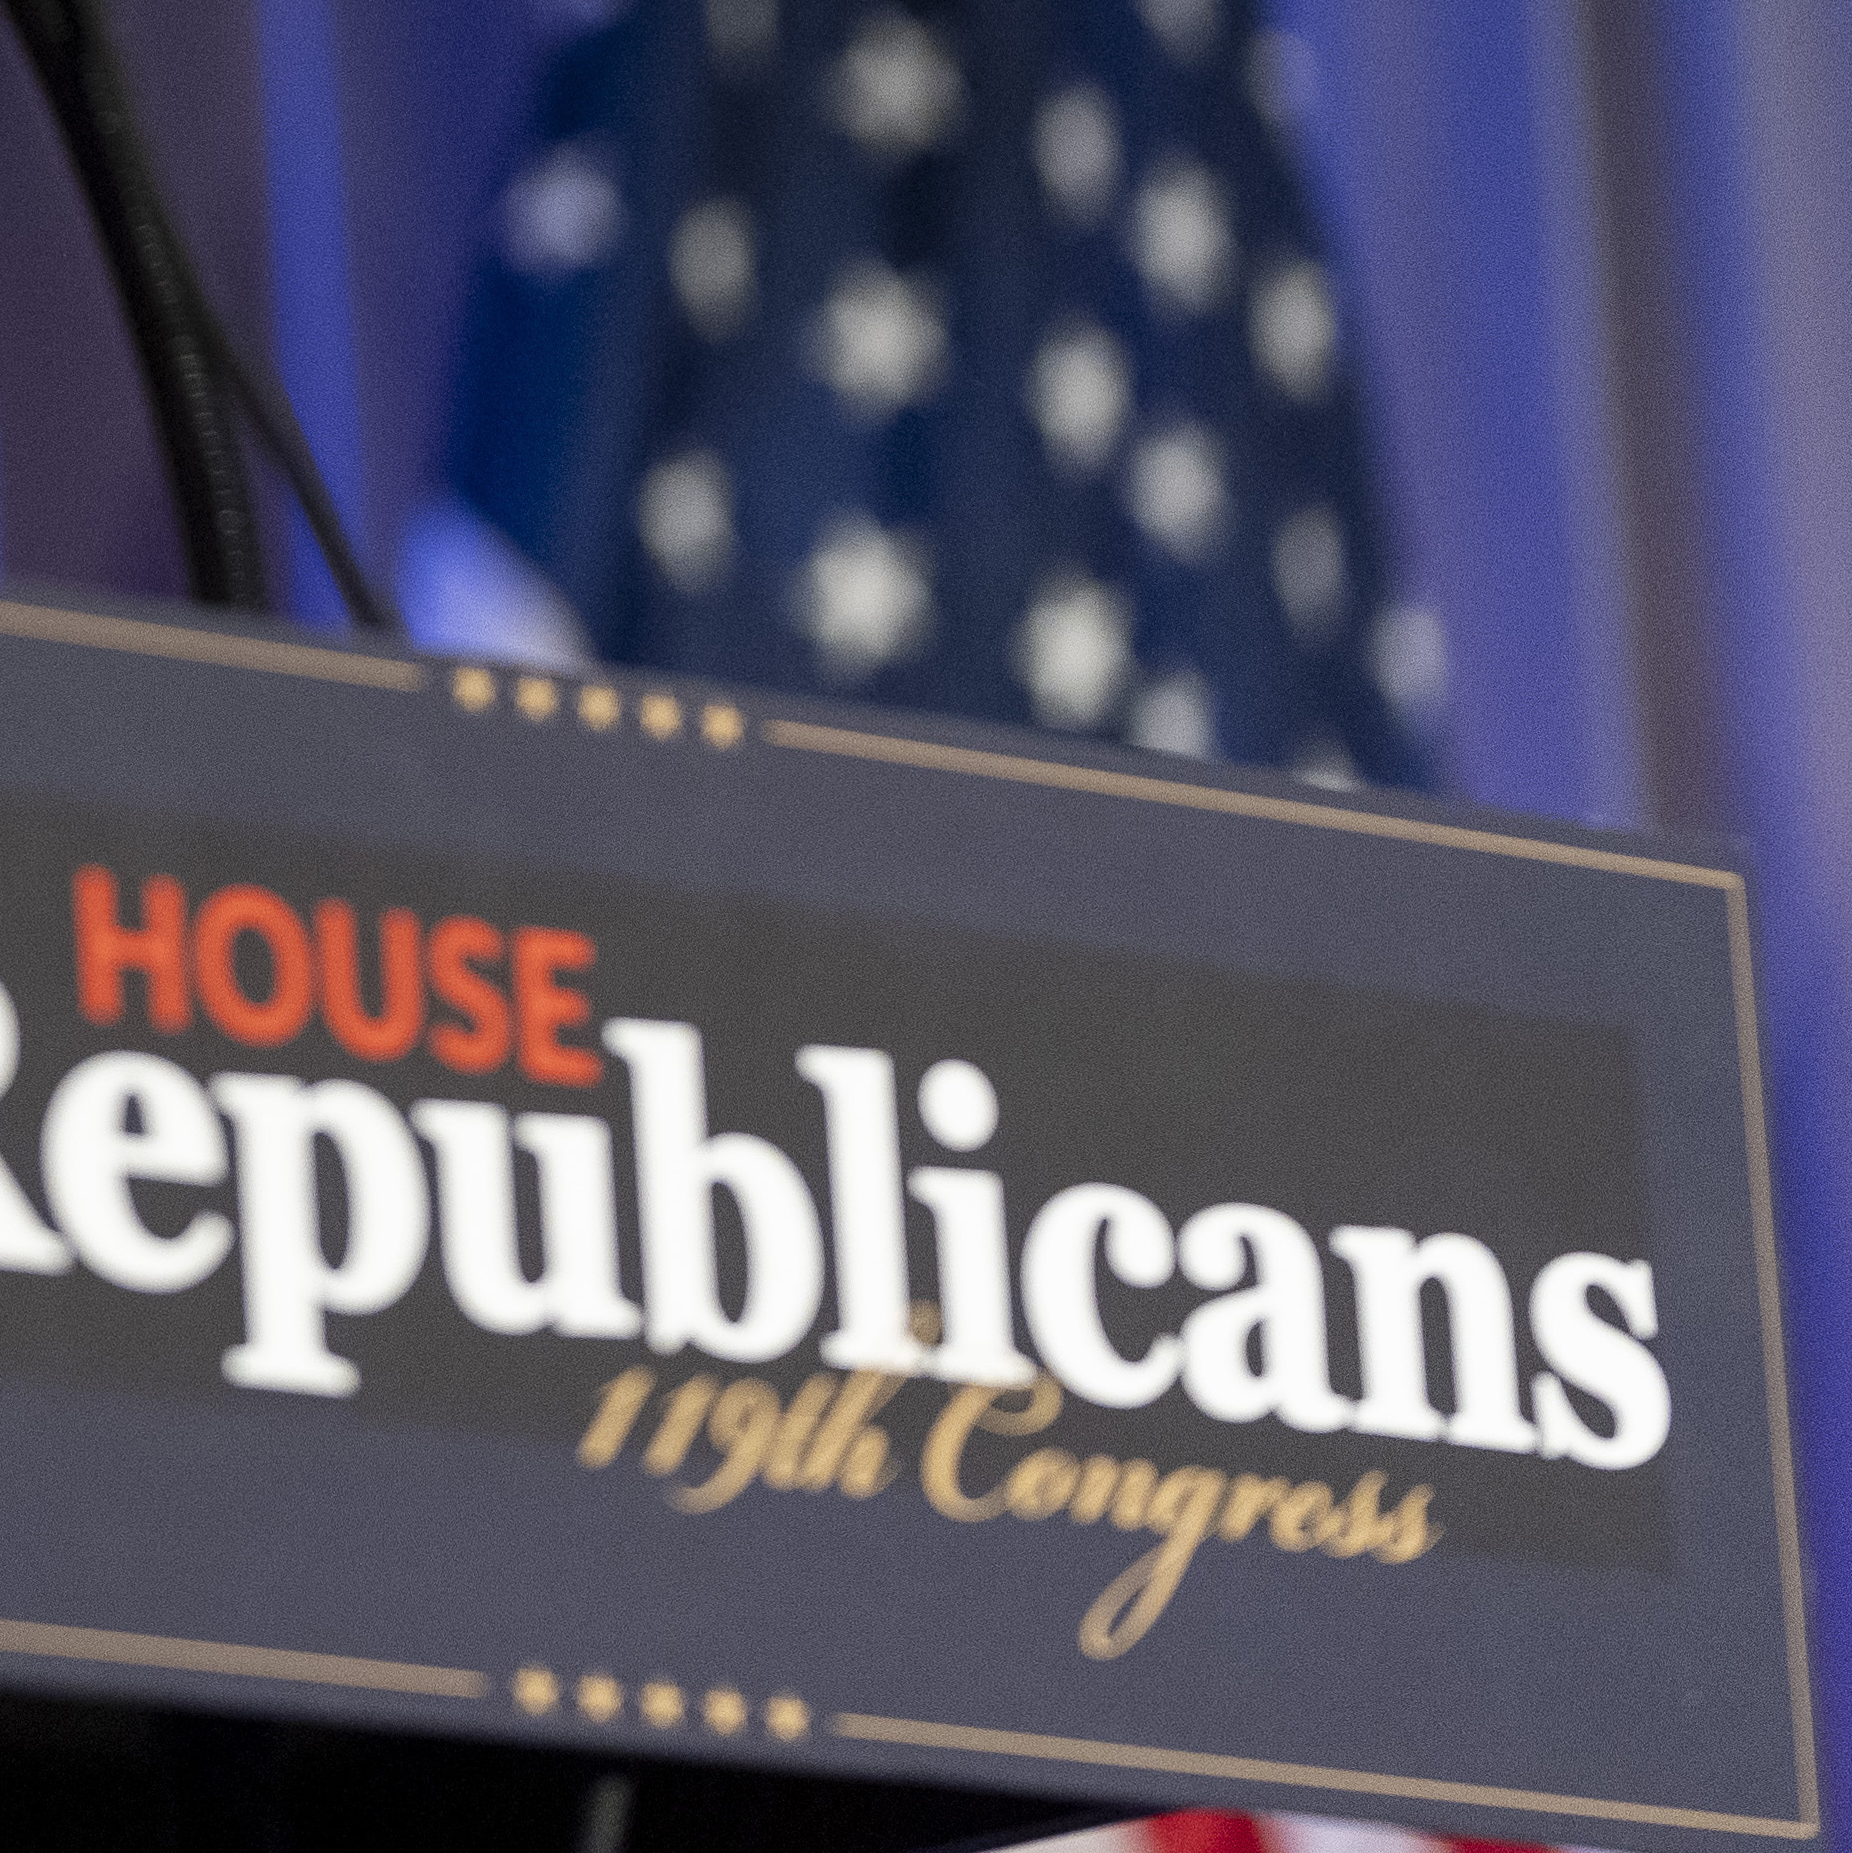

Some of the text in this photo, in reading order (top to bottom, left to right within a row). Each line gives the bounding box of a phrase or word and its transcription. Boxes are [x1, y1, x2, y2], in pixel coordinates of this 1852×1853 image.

[72, 865, 604, 1086] HOUSE
[576, 1300, 1445, 1660] 119th Congress
